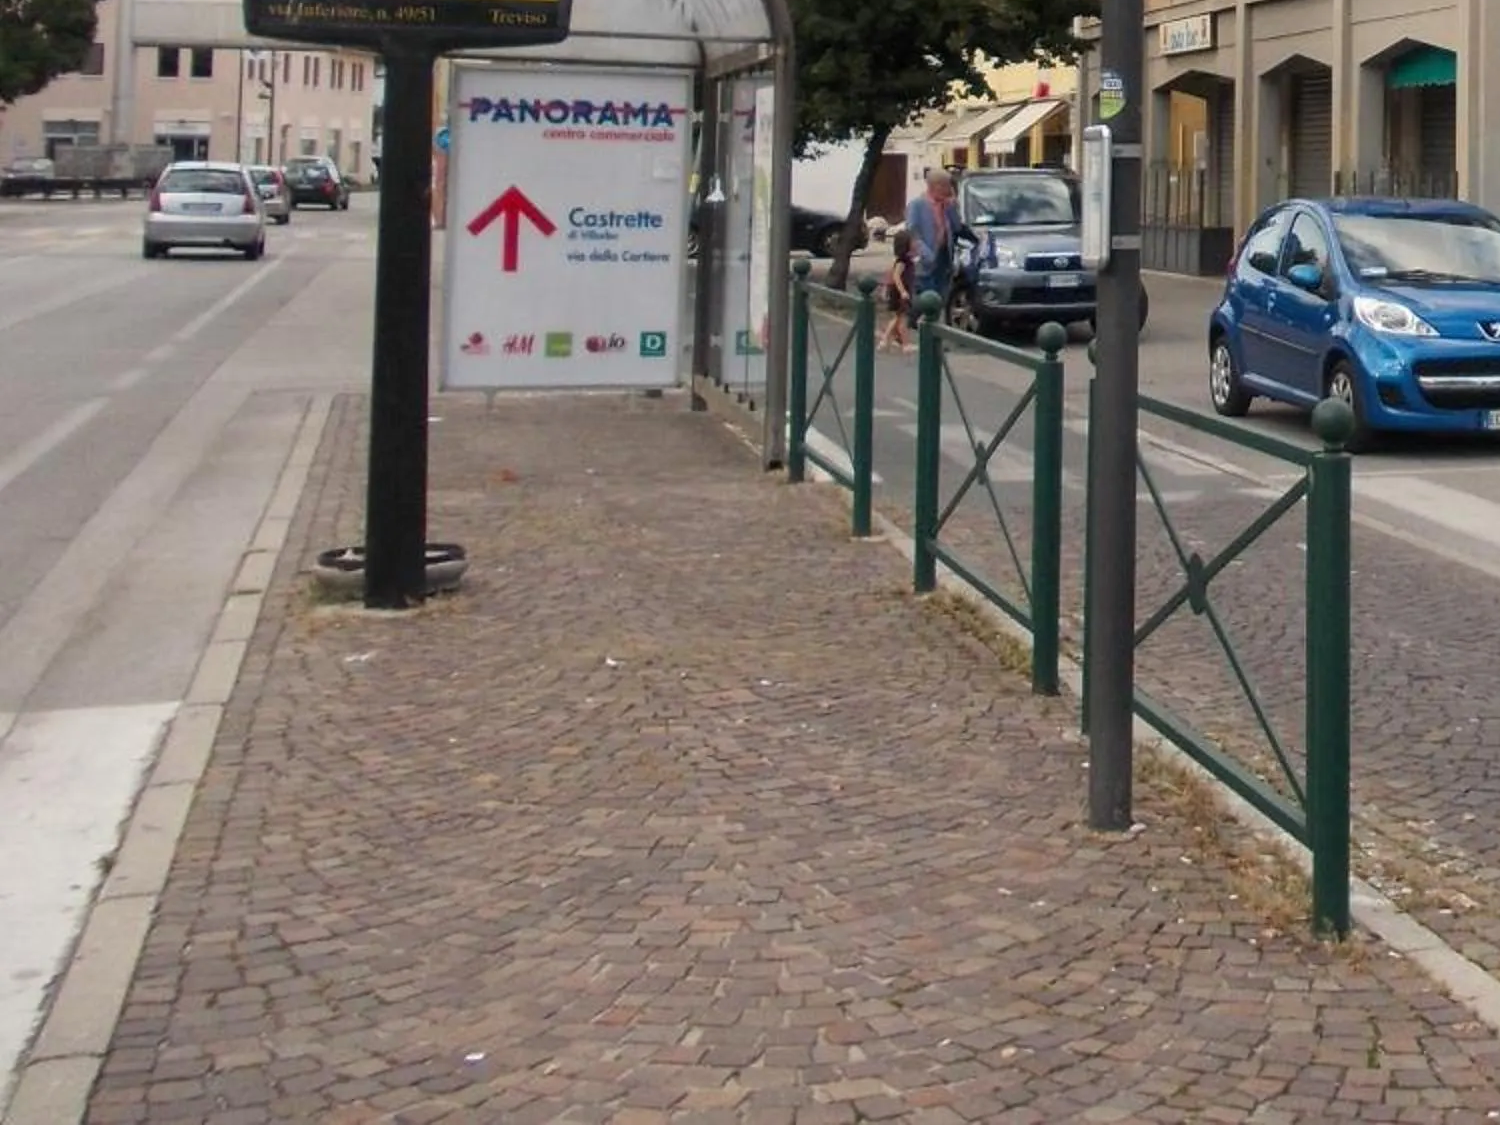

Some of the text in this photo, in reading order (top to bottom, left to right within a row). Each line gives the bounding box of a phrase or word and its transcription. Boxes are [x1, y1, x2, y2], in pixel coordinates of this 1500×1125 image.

[488, 8, 548, 24] Treviso
[469, 96, 675, 128] PANORAMA
[568, 206, 663, 228] Castrette
